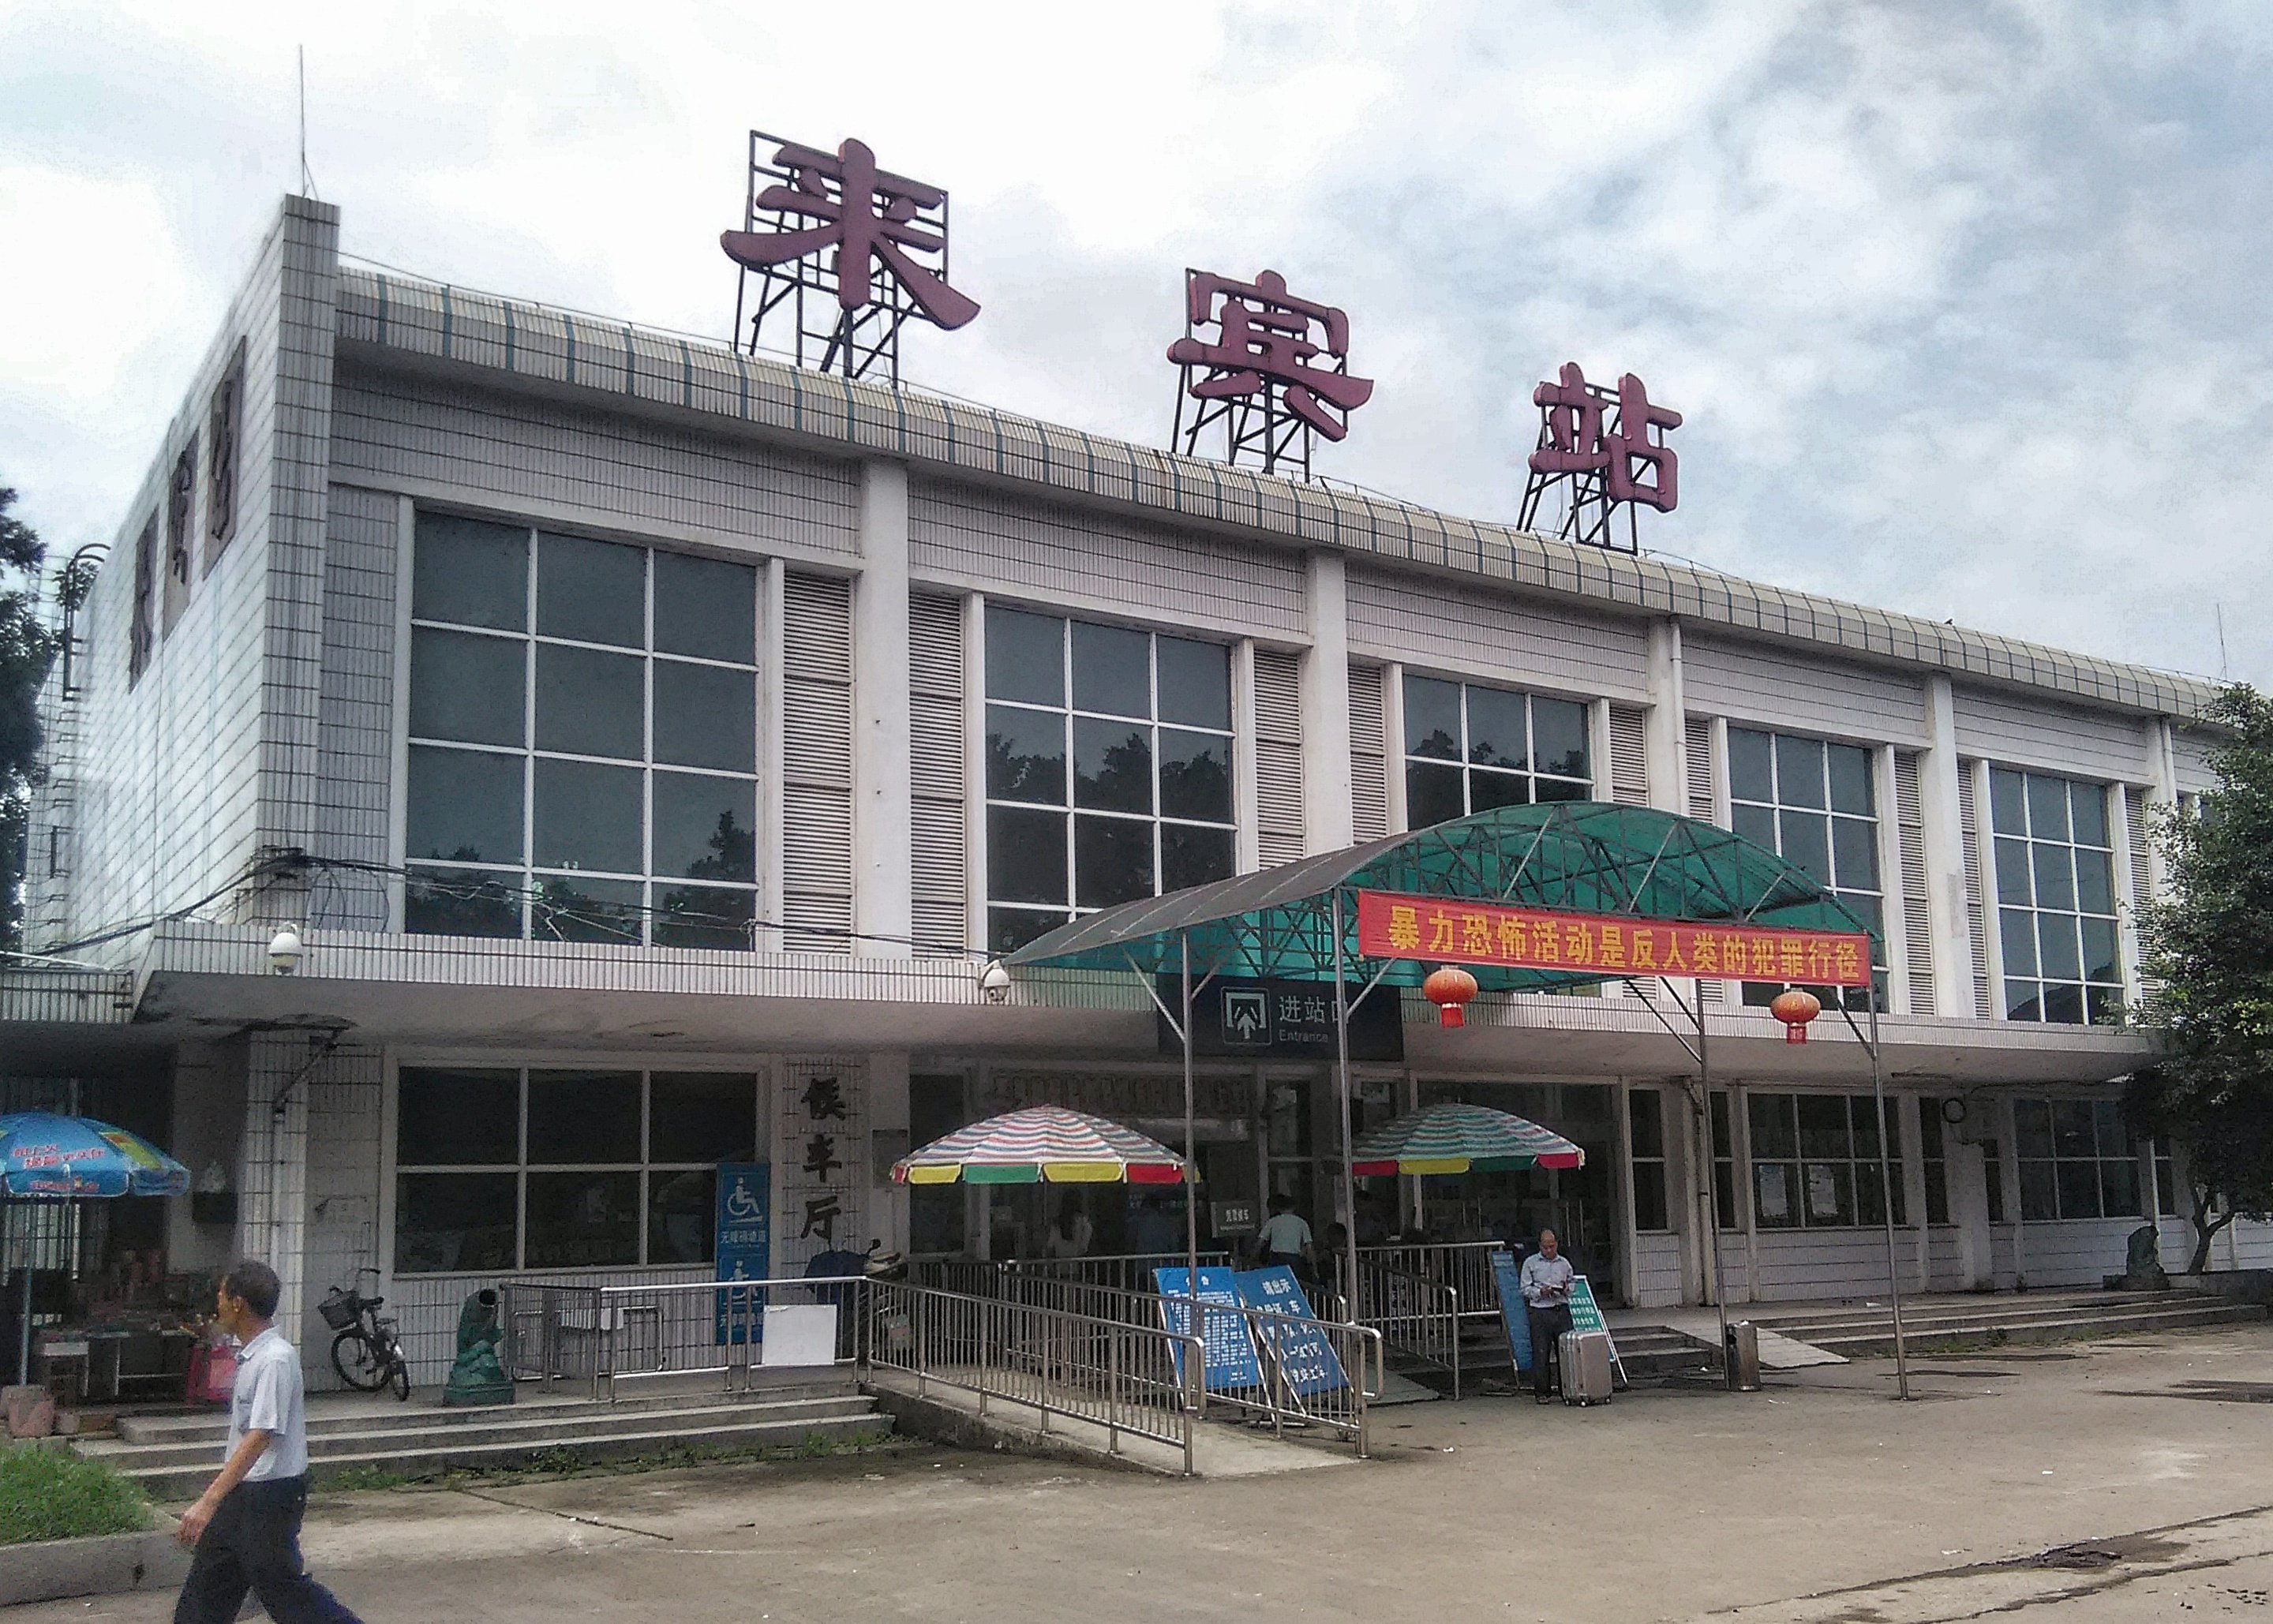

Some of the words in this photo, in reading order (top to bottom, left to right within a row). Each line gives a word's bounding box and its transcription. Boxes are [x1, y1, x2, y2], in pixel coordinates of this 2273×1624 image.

[720, 137, 1683, 513] 来宾站
[1387, 904, 1860, 979] 暴力恐怖活动是反人类的犯罪行径
[1279, 1029, 1328, 1042] Entrance
[800, 1076, 847, 1244] 候车厅
[1262, 1278, 1292, 1295] 请出示
